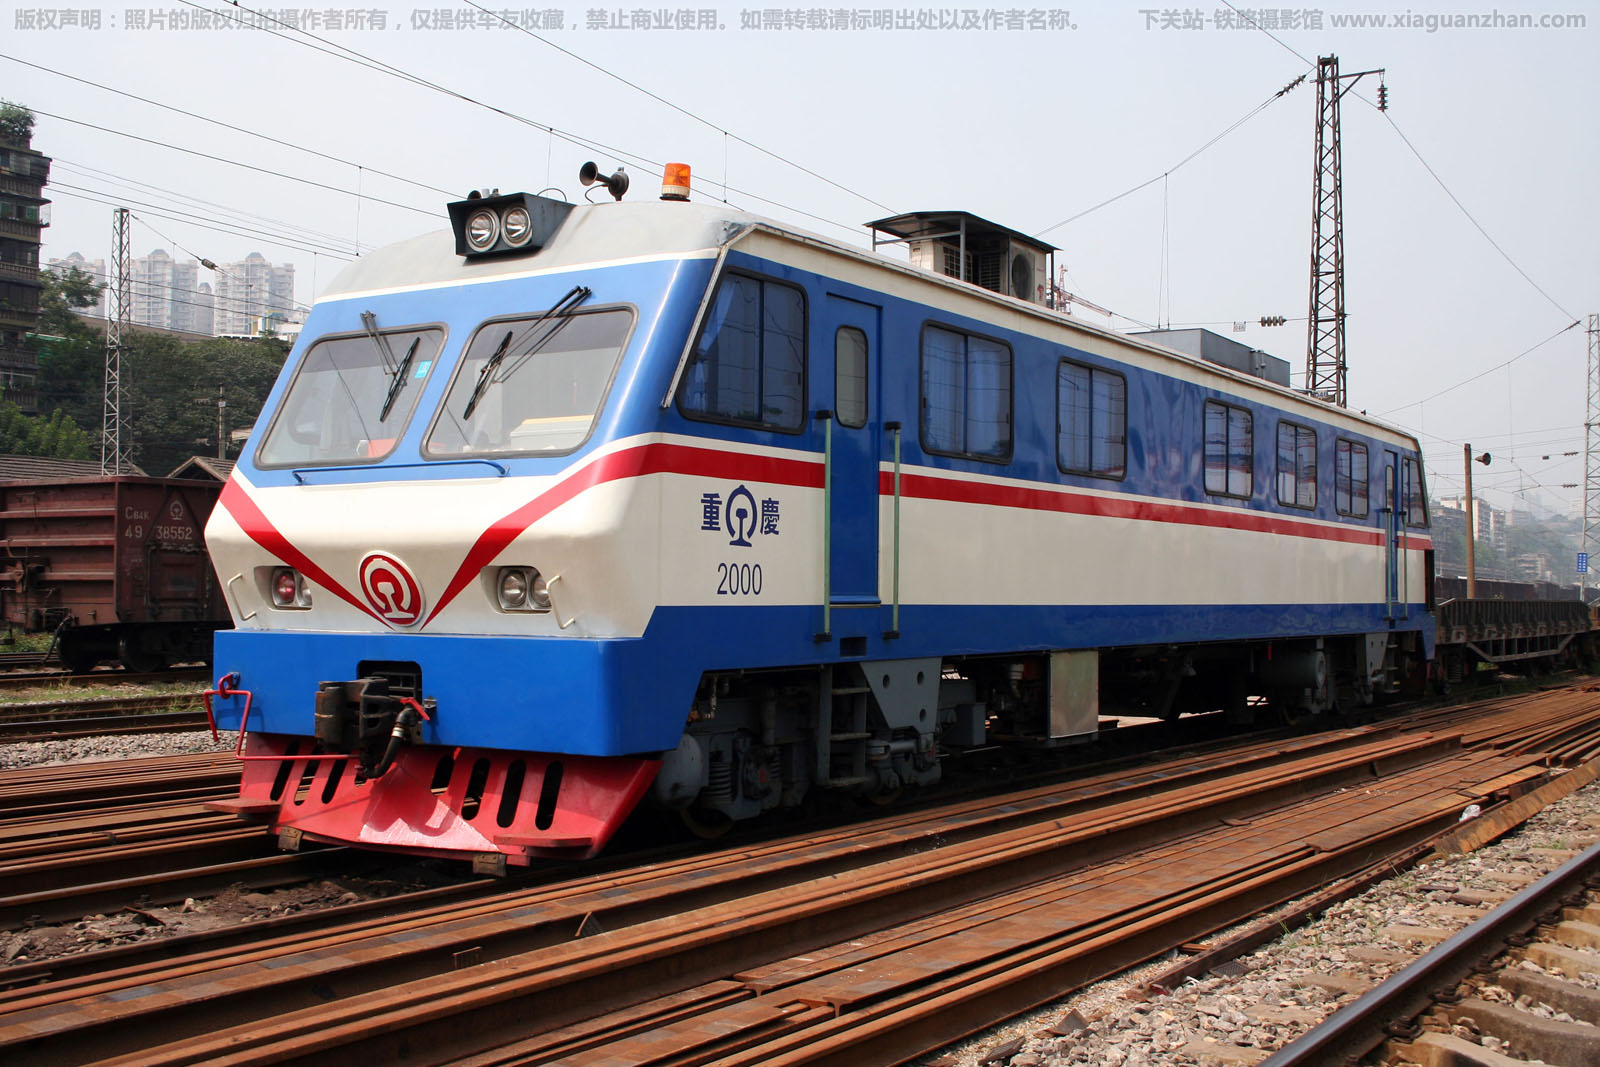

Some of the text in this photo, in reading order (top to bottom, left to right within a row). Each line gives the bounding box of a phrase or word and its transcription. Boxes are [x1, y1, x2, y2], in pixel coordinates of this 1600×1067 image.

[700, 493, 780, 535] 重 慶
[124, 525, 193, 540] 49 38552
[716, 562, 762, 595] 2000
